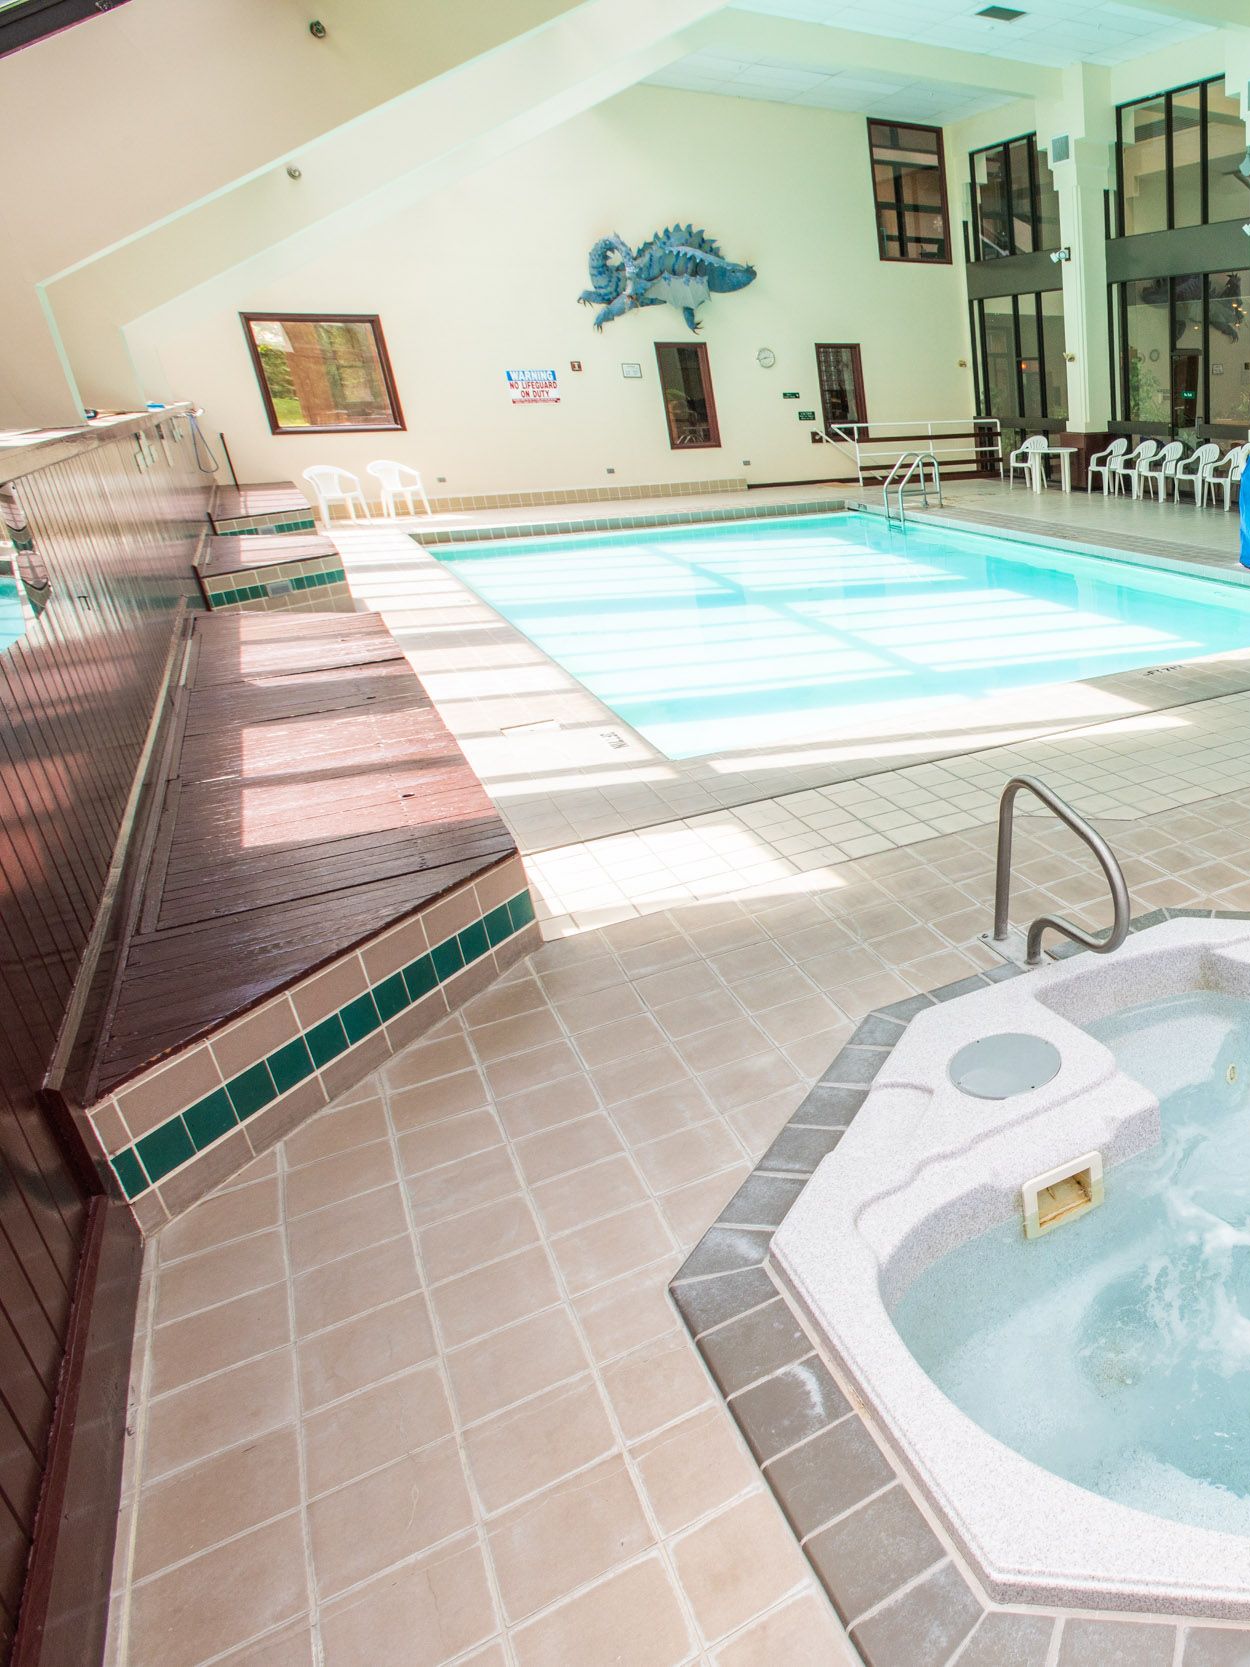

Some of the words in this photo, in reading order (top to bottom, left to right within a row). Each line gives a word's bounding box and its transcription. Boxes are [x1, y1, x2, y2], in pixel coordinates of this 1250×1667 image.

[510, 370, 553, 381] WARNING
[522, 381, 557, 389] LIFEGUARD
[521, 390, 530, 398] ON
[532, 390, 550, 398] DUTY
